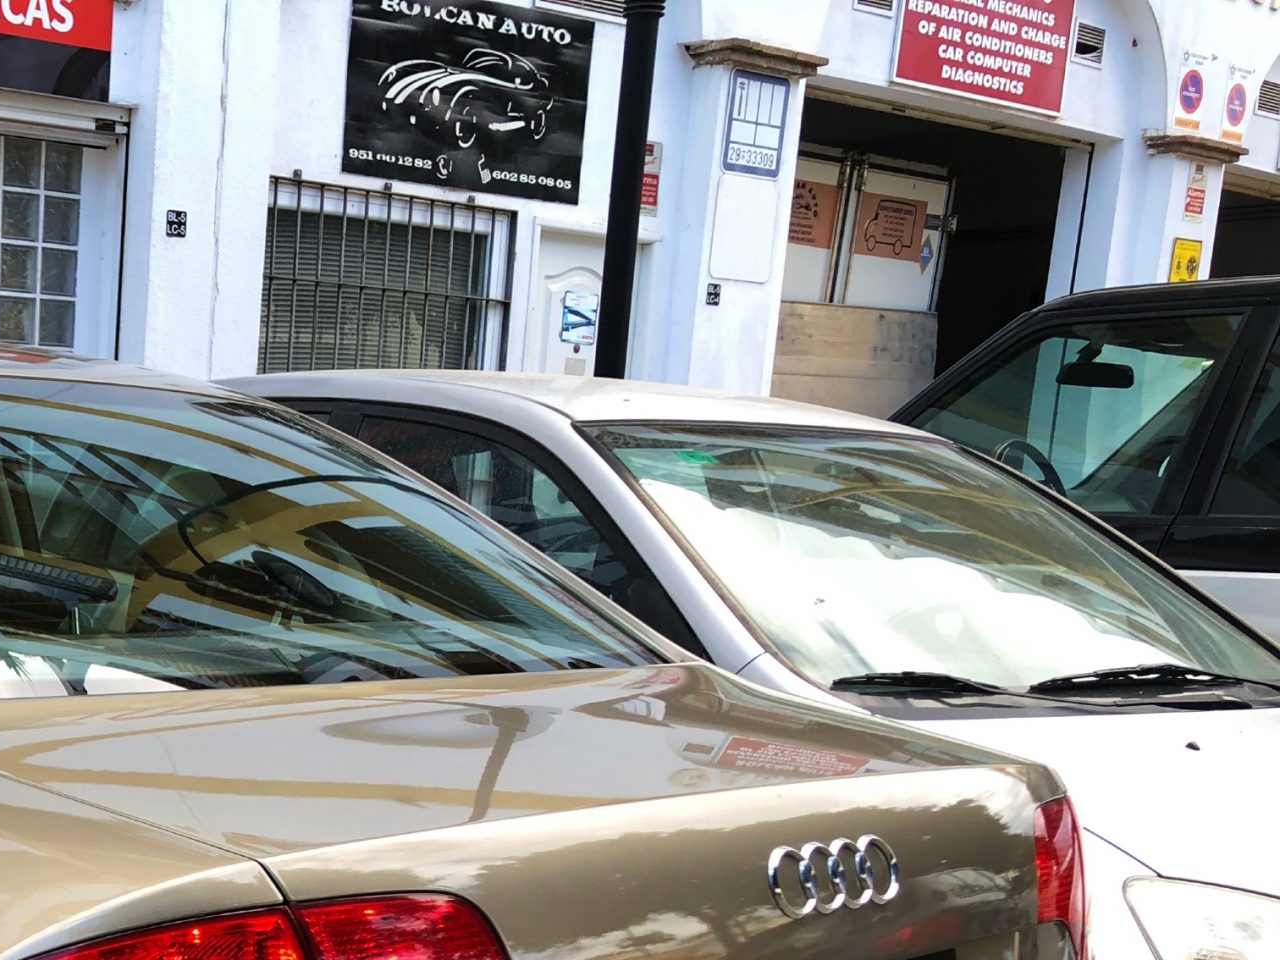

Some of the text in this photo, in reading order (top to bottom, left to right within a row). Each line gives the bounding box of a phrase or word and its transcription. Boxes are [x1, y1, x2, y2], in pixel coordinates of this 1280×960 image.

[907, 0, 1067, 49] REPARATION AND CHARGE
[986, 0, 1056, 28] MECHANICS
[498, 18, 571, 45] AUTO
[917, 20, 1054, 65] OF AIR CONDITIONERS
[938, 44, 1032, 78] CAR COMPUTER
[941, 65, 1025, 95] DIAGNOSTICS
[349, 148, 373, 161] 951
[397, 155, 413, 167] 12
[414, 158, 433, 170] 82
[491, 170, 573, 190] 602 85 08 05
